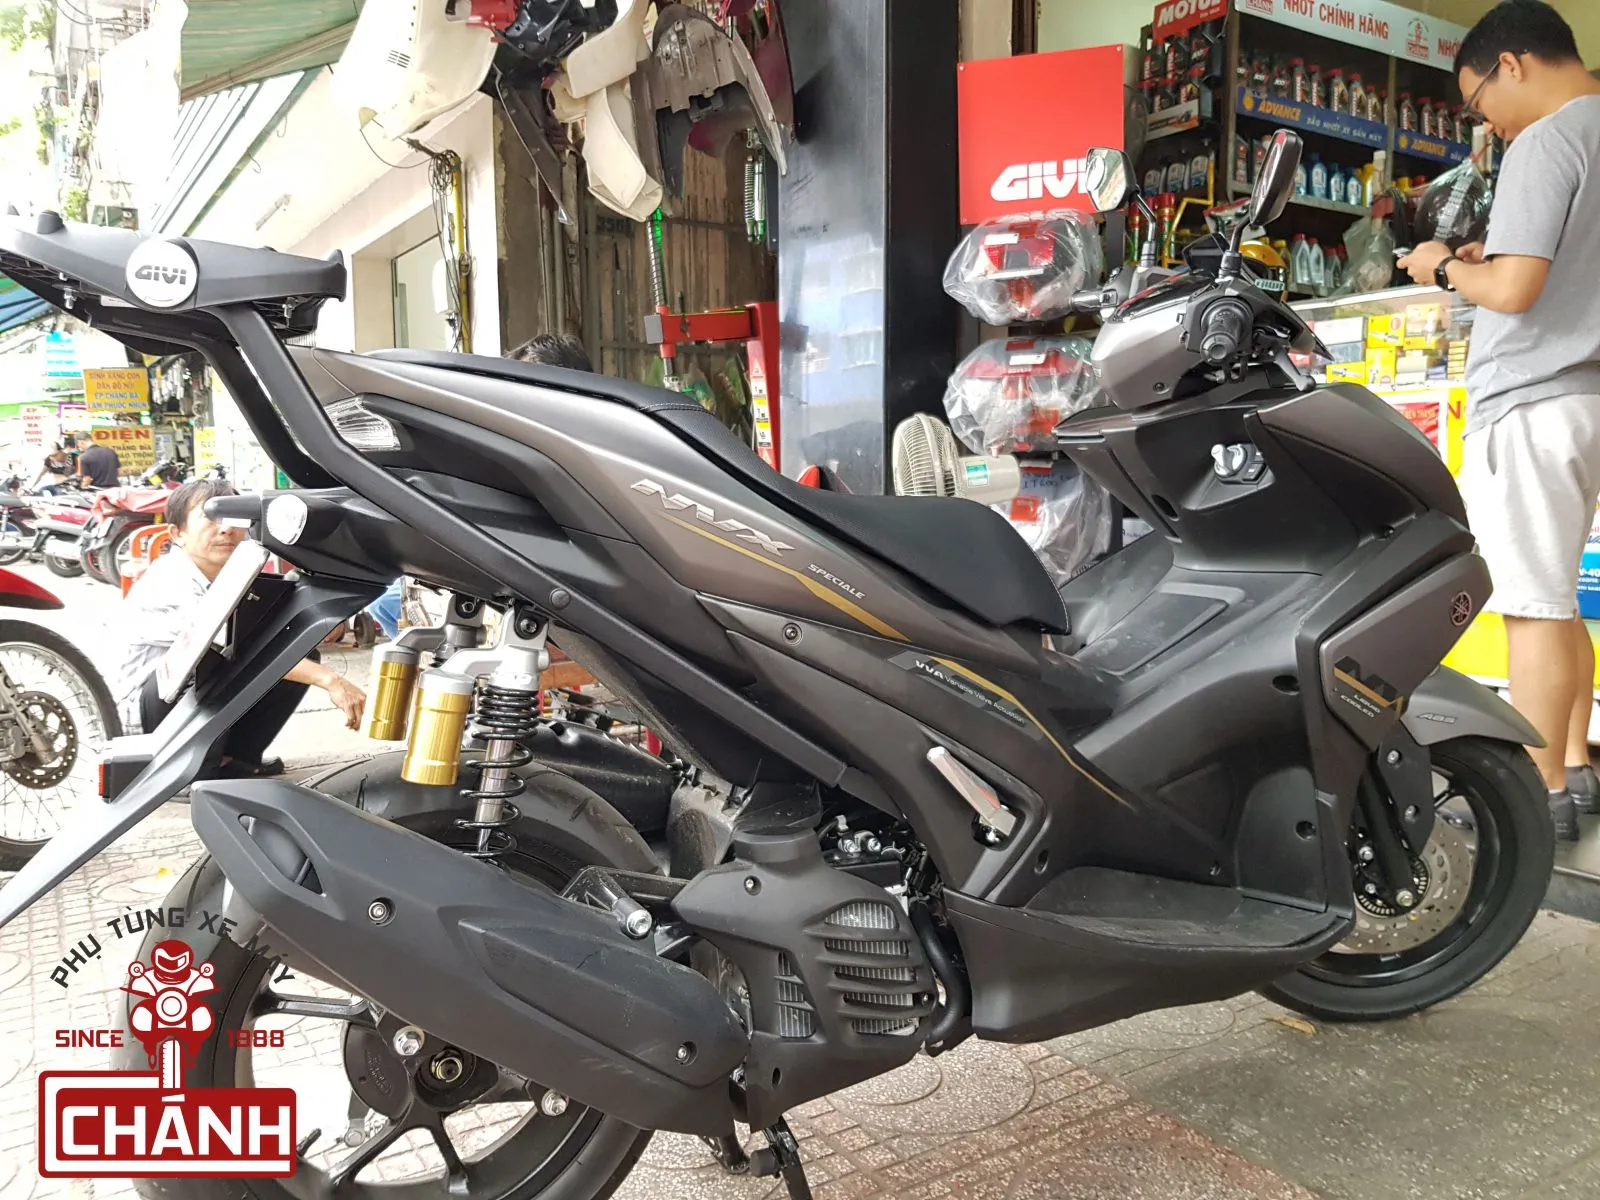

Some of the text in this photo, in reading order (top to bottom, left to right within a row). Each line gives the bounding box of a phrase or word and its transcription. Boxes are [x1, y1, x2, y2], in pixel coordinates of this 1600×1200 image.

[1319, 1, 1354, 30] CHÍNH
[1358, 13, 1389, 40] HÃNG
[990, 157, 1087, 202] GIVI
[135, 265, 187, 285] GIVI
[807, 563, 866, 600] SPECIALE
[915, 660, 944, 680] VVA
[1417, 712, 1459, 725] ABS
